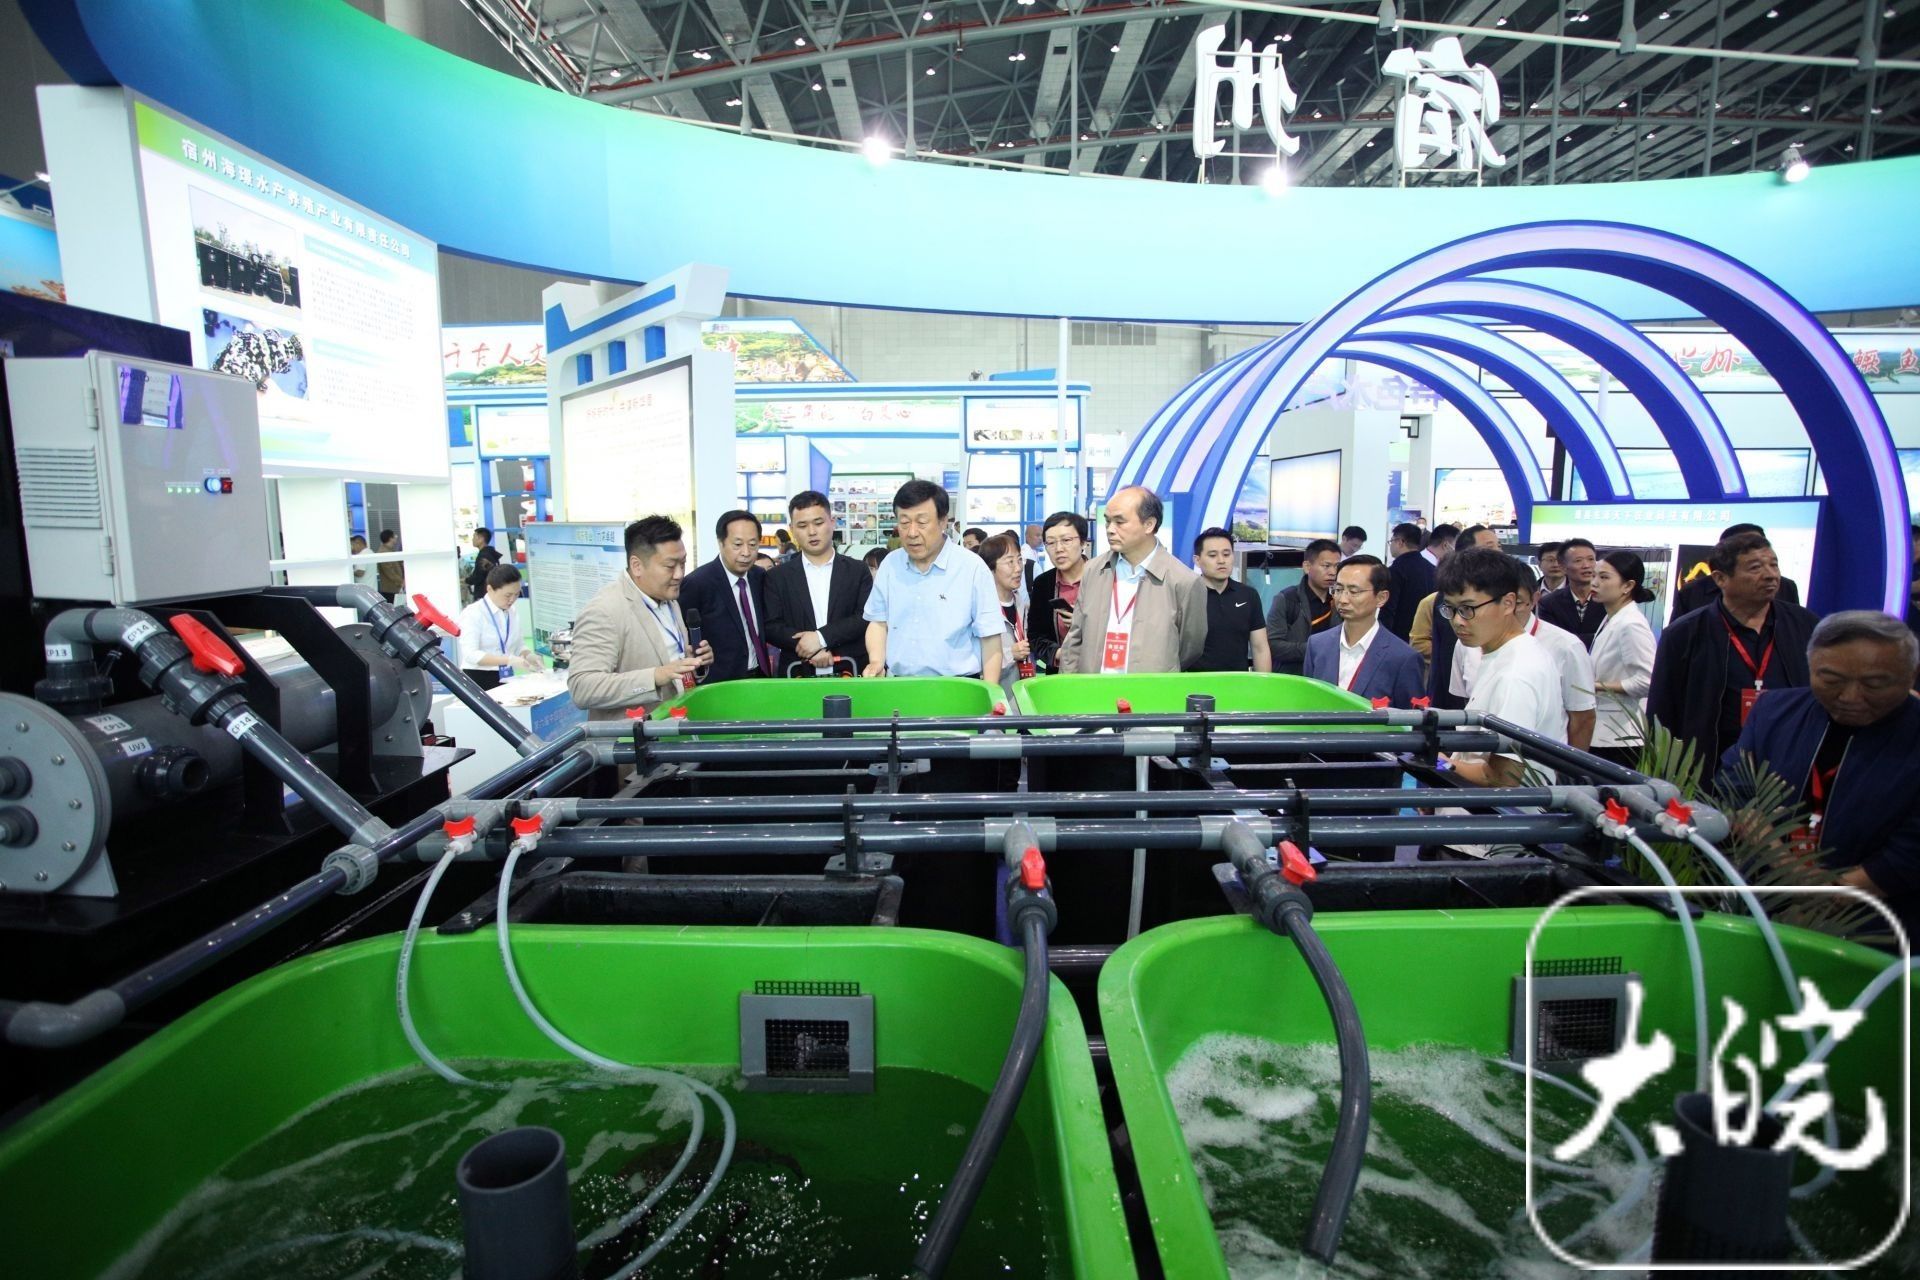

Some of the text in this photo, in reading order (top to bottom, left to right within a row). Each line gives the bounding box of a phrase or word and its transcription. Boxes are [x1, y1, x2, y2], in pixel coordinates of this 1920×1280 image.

[126, 623, 151, 642] CP14
[231, 716, 252, 735] CP14
[128, 742, 146, 752] UV3
